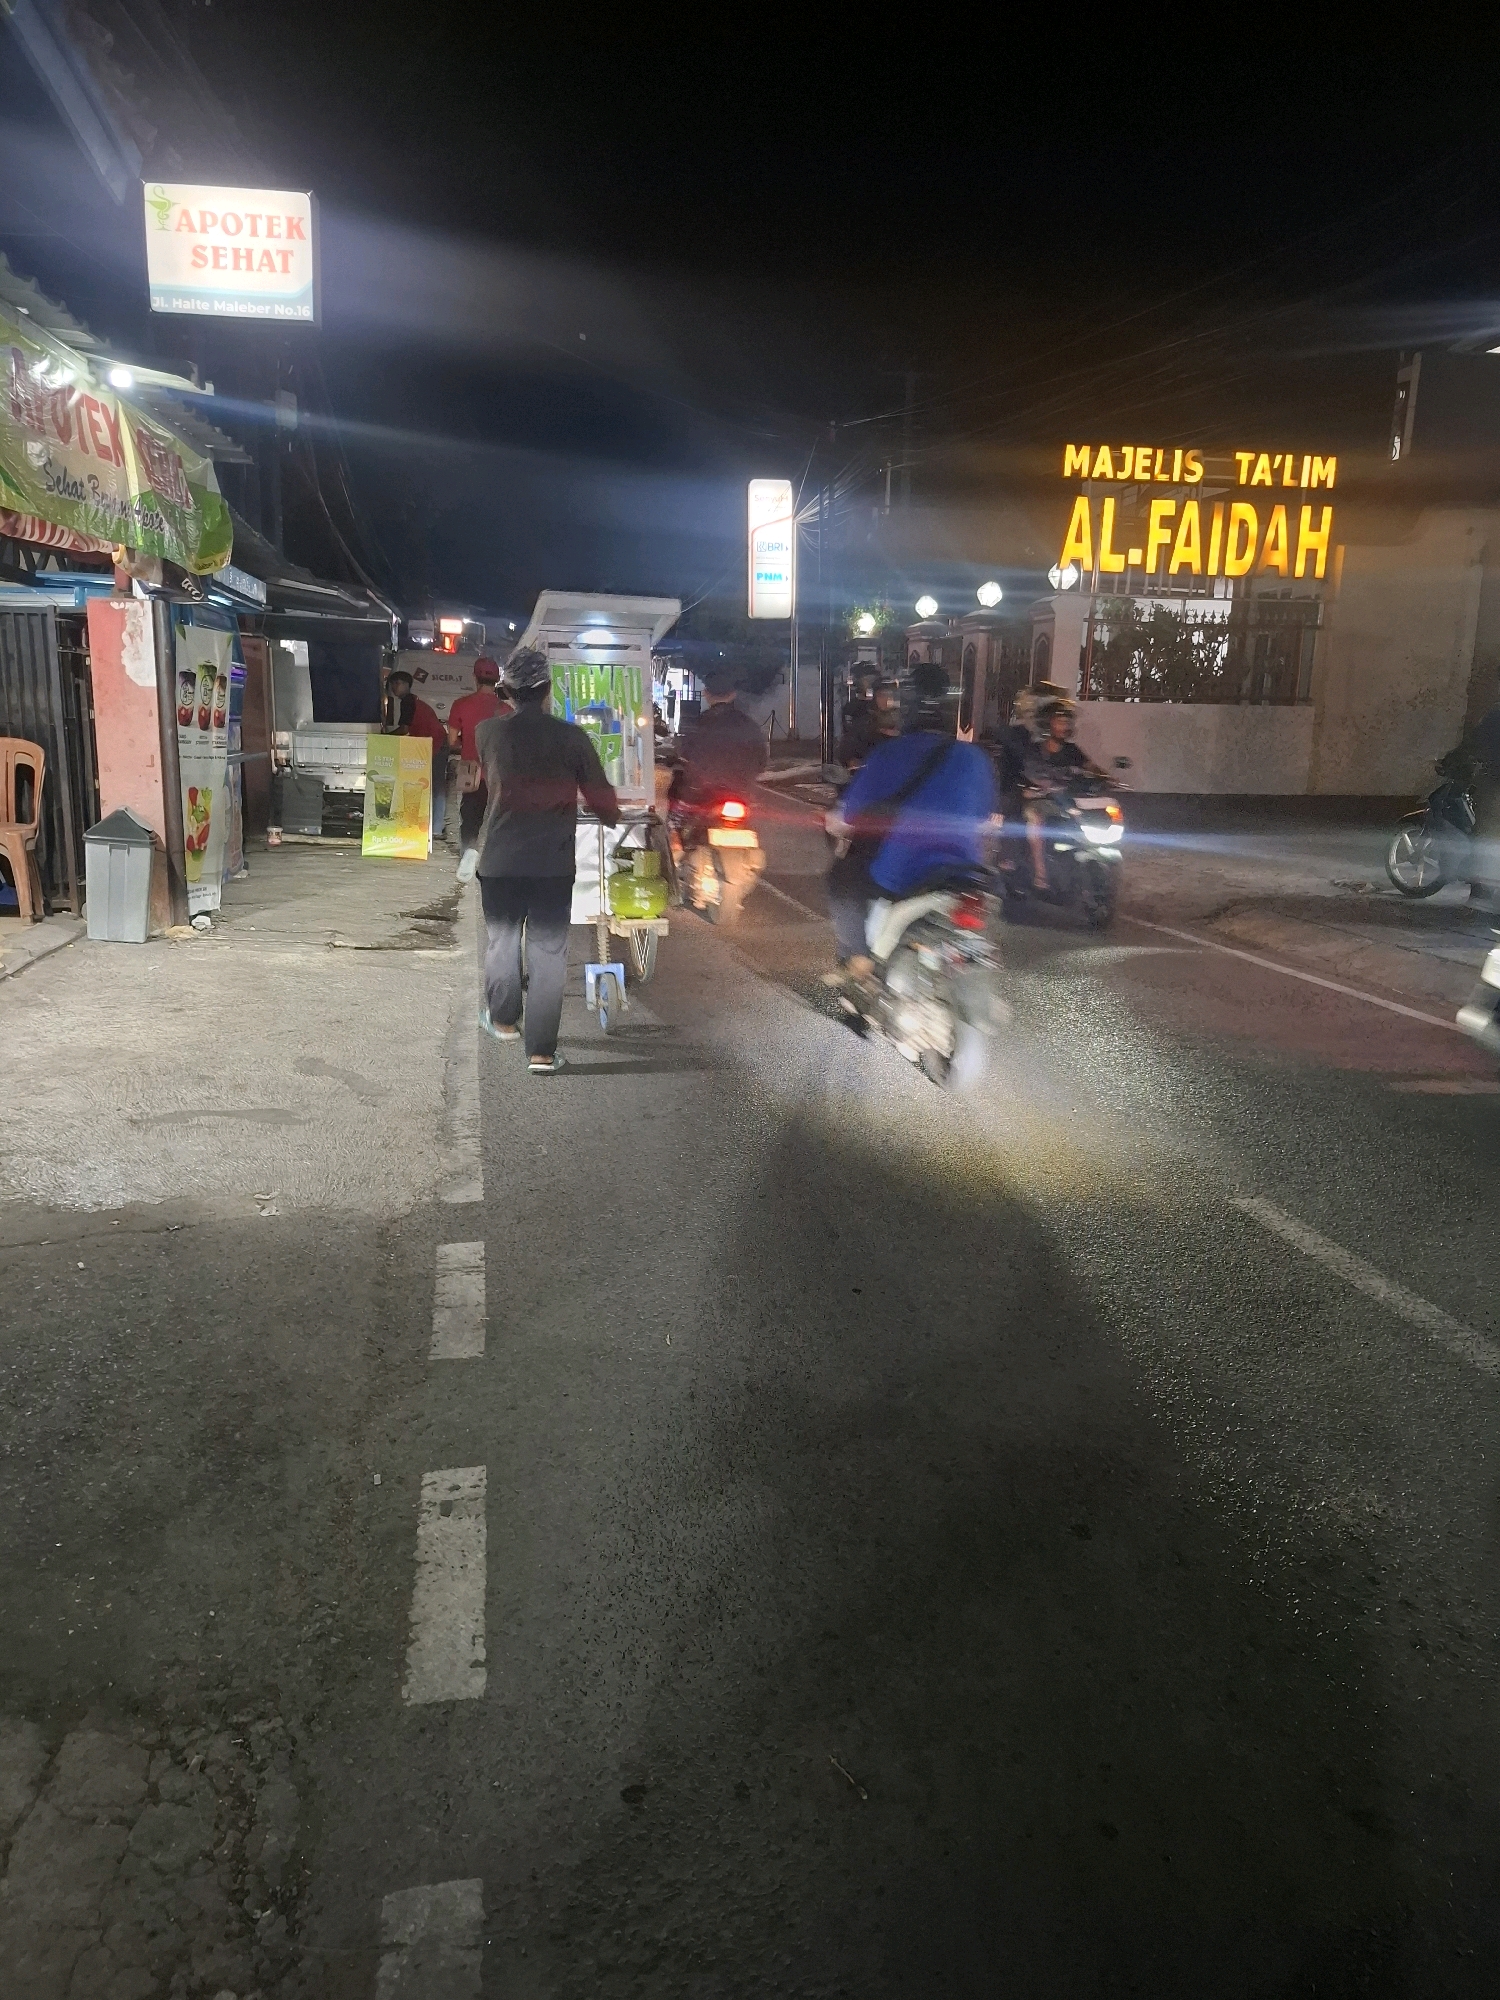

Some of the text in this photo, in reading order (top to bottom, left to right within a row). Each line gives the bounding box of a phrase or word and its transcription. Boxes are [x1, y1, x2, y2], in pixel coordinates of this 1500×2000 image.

[175, 208, 307, 241] APOTEK
[190, 244, 294, 274] SEHAT
[152, 296, 311, 317] Jl. Halte Maleber No.16
[43, 457, 87, 500] Sehat
[1063, 444, 1337, 489] MAJELIS TA'LIM
[1059, 496, 1333, 579] AL-FAIDAH
[756, 572, 783, 581] PNM
